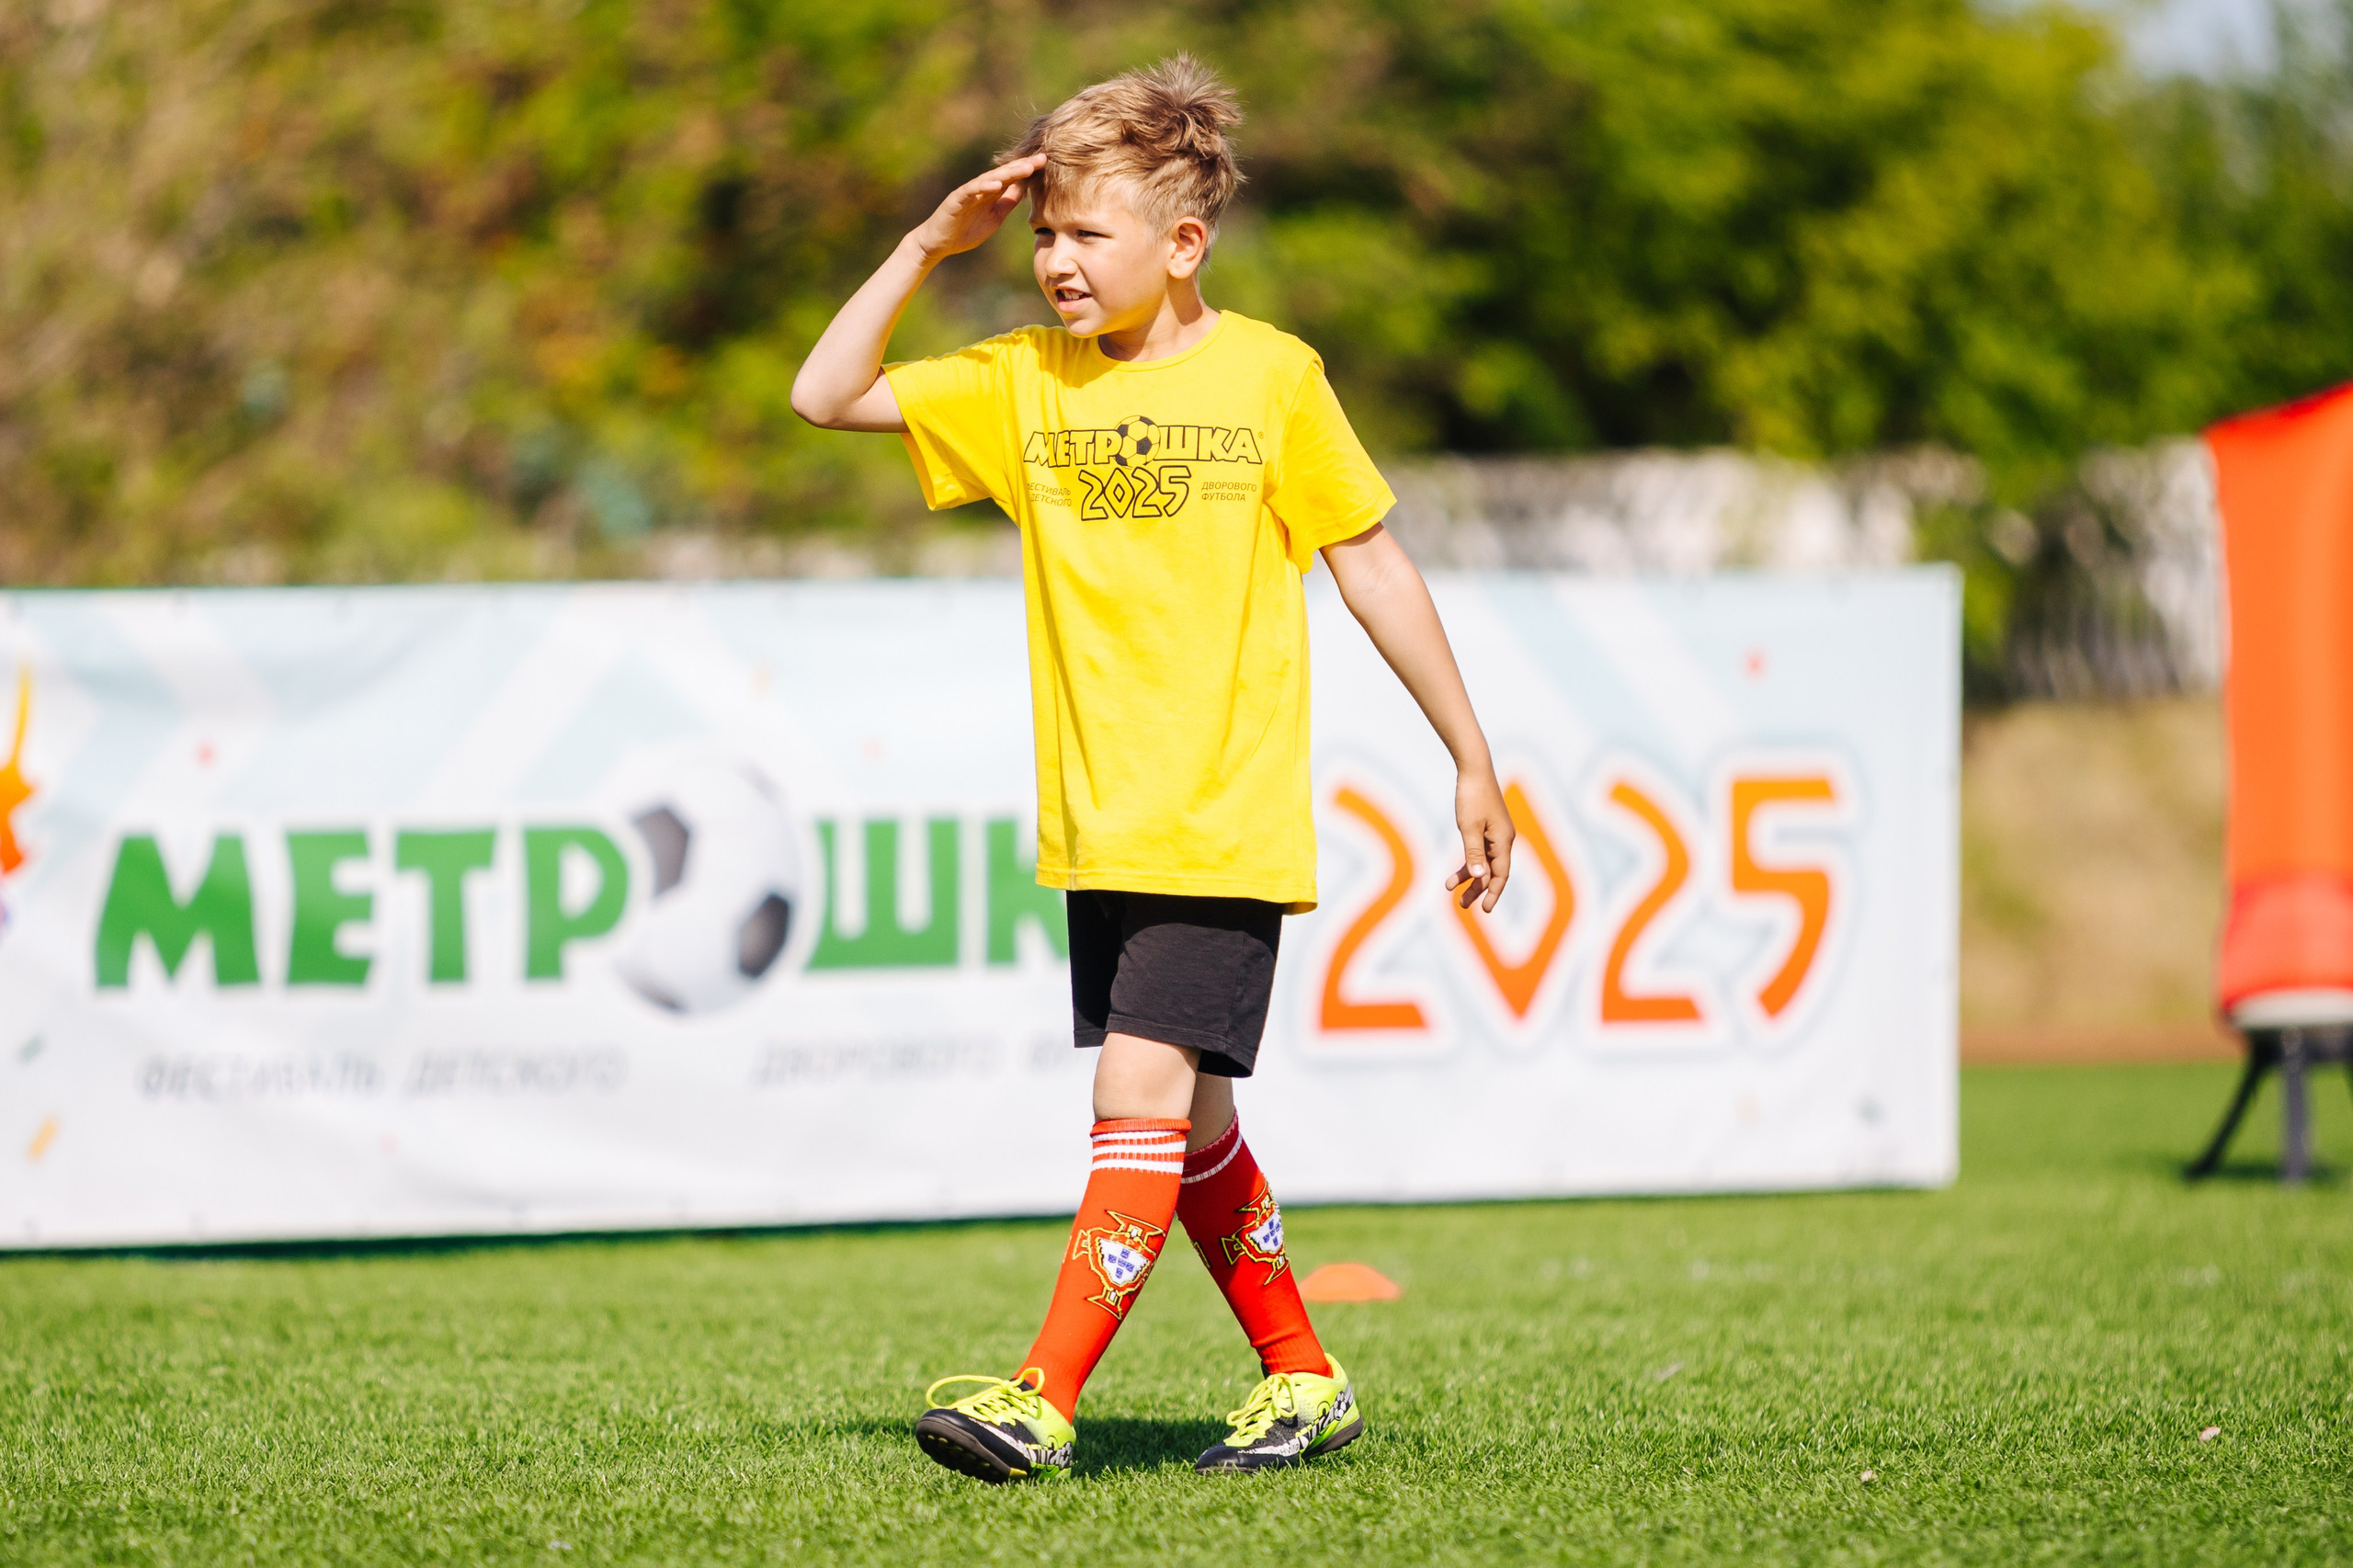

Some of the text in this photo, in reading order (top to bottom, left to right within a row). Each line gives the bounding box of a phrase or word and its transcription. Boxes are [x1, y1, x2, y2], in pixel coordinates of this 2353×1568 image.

[1078, 465, 1191, 521] 2025
[1201, 481, 1257, 493] ДВОРОВОГО
[1201, 493, 1246, 502] ФУТБОЛА
[94, 758, 1069, 1015] МЕТРОШК
[1317, 777, 1836, 1031] 2025
